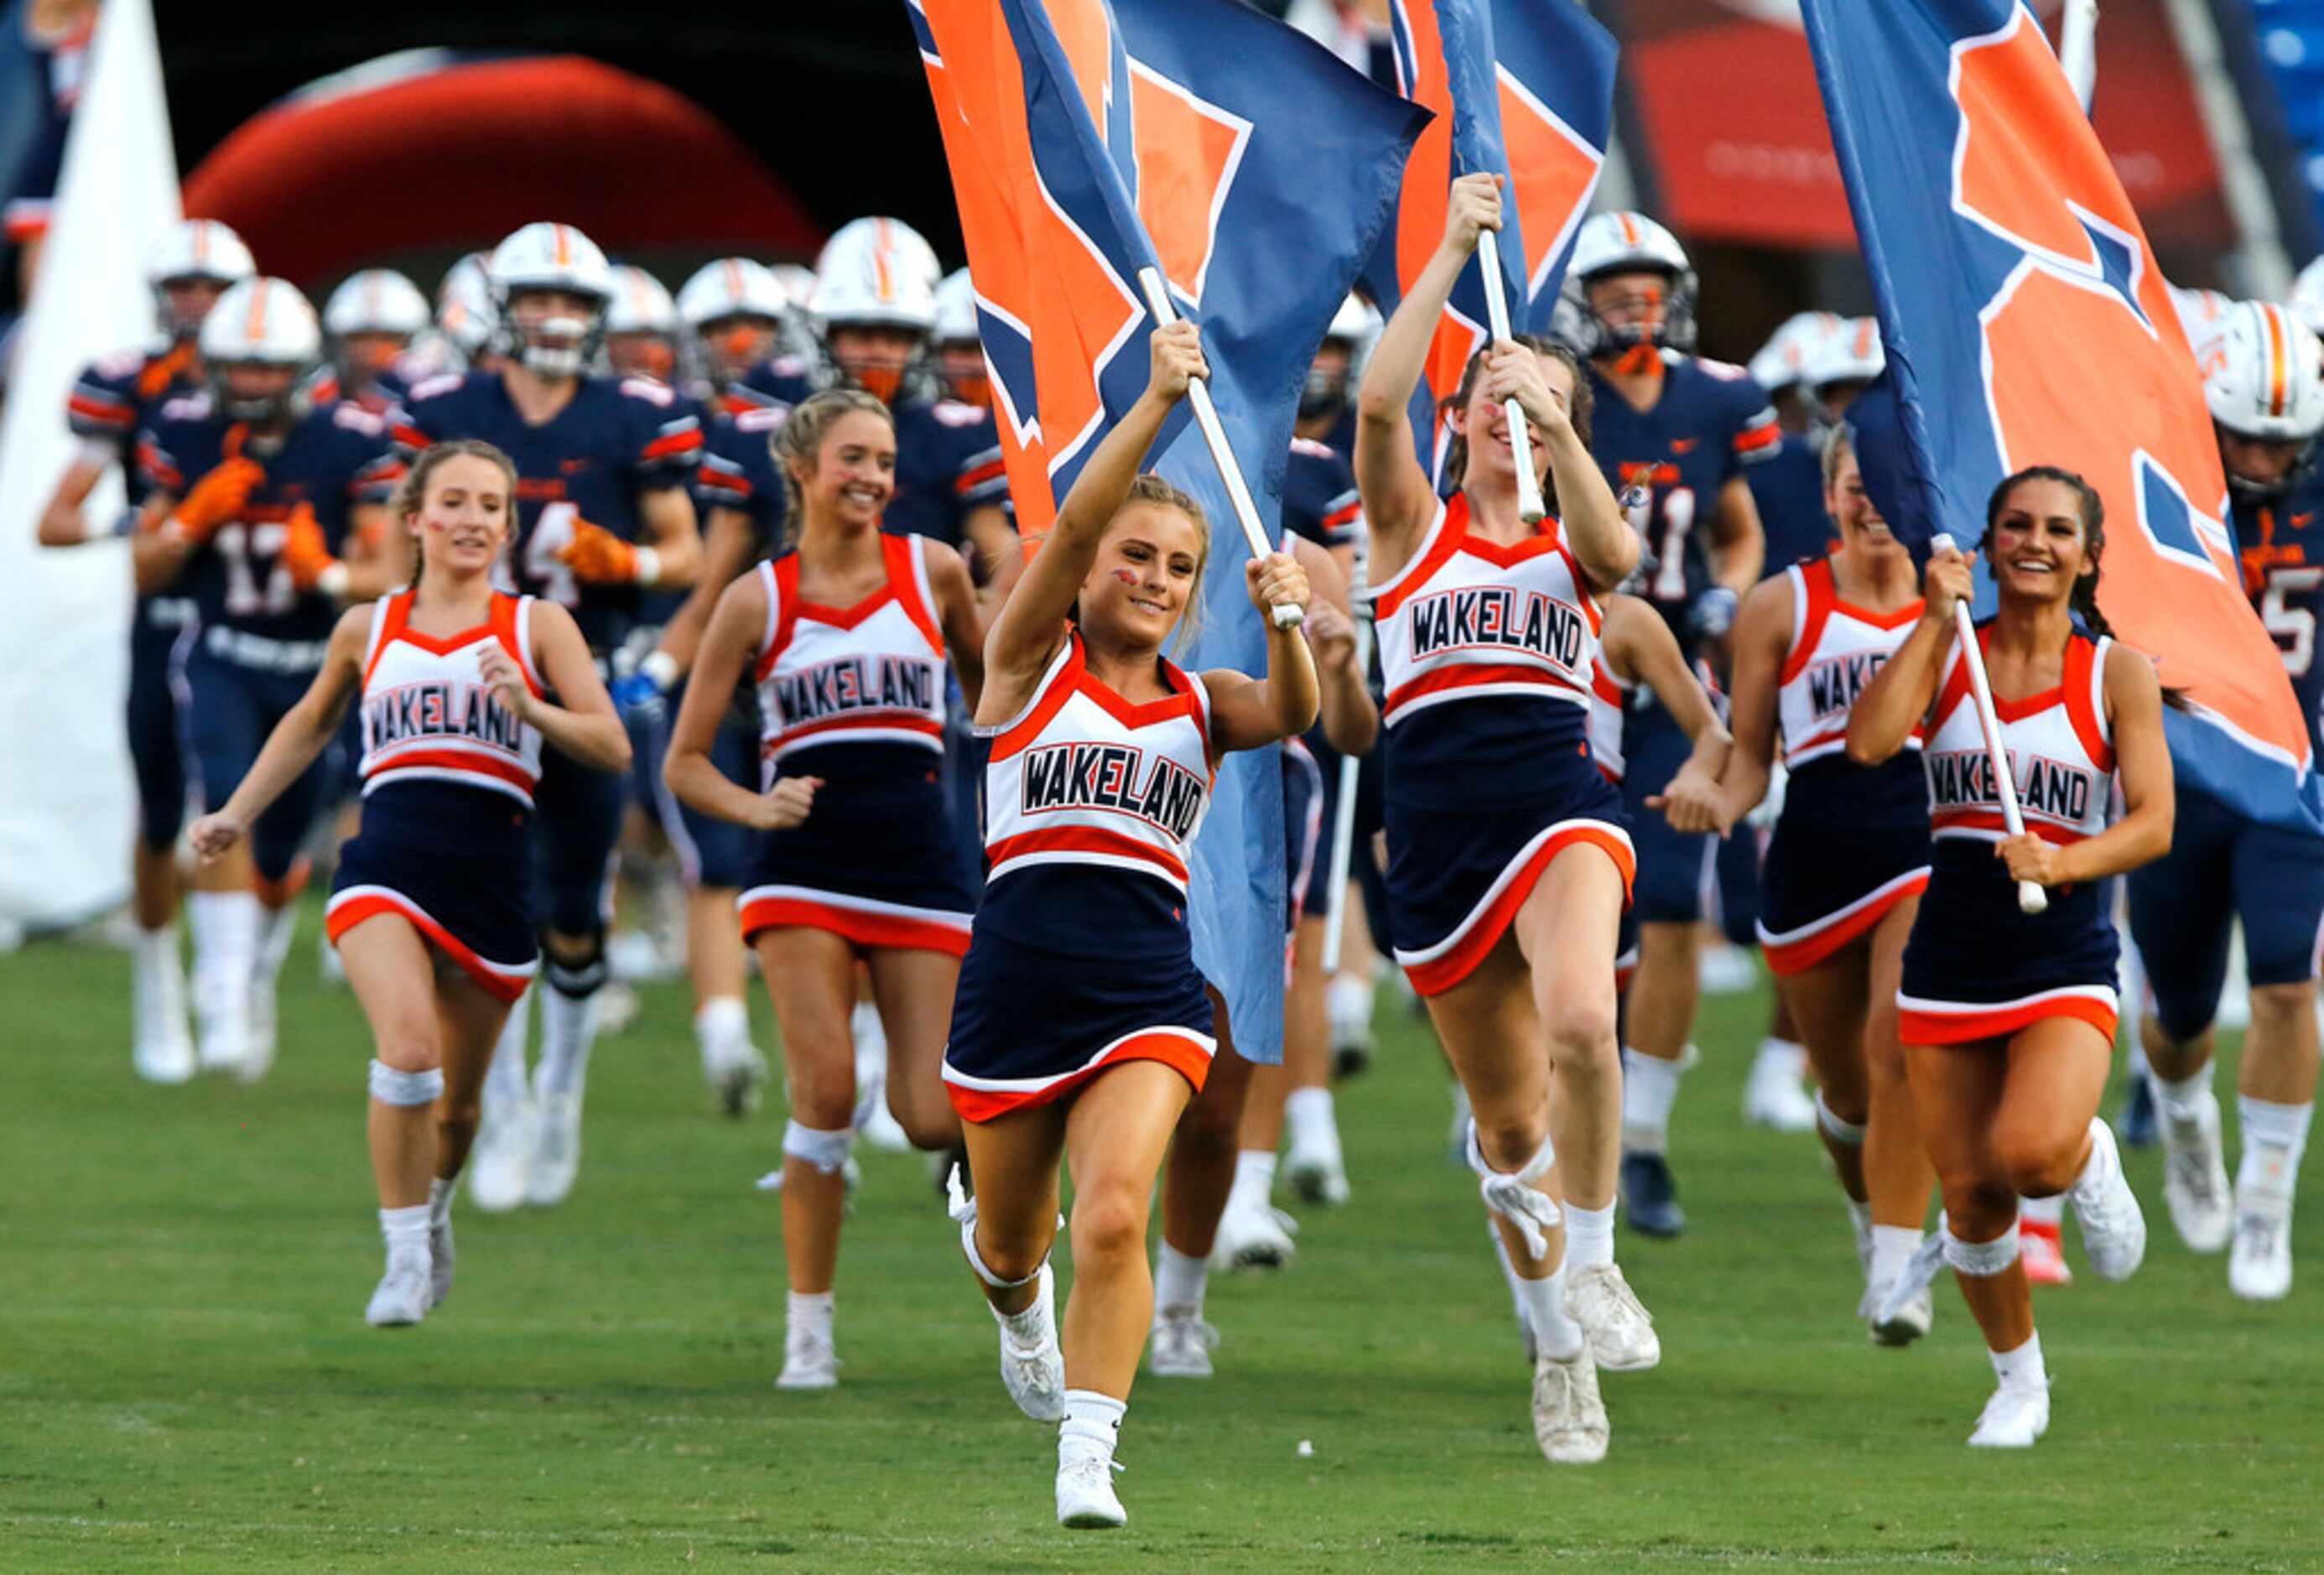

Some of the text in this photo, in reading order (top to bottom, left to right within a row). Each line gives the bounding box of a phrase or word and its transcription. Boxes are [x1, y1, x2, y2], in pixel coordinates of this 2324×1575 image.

[1412, 590, 1583, 671] WAKELAND
[777, 658, 933, 727] WAKELAND
[1024, 745, 1204, 839] WAKELAND
